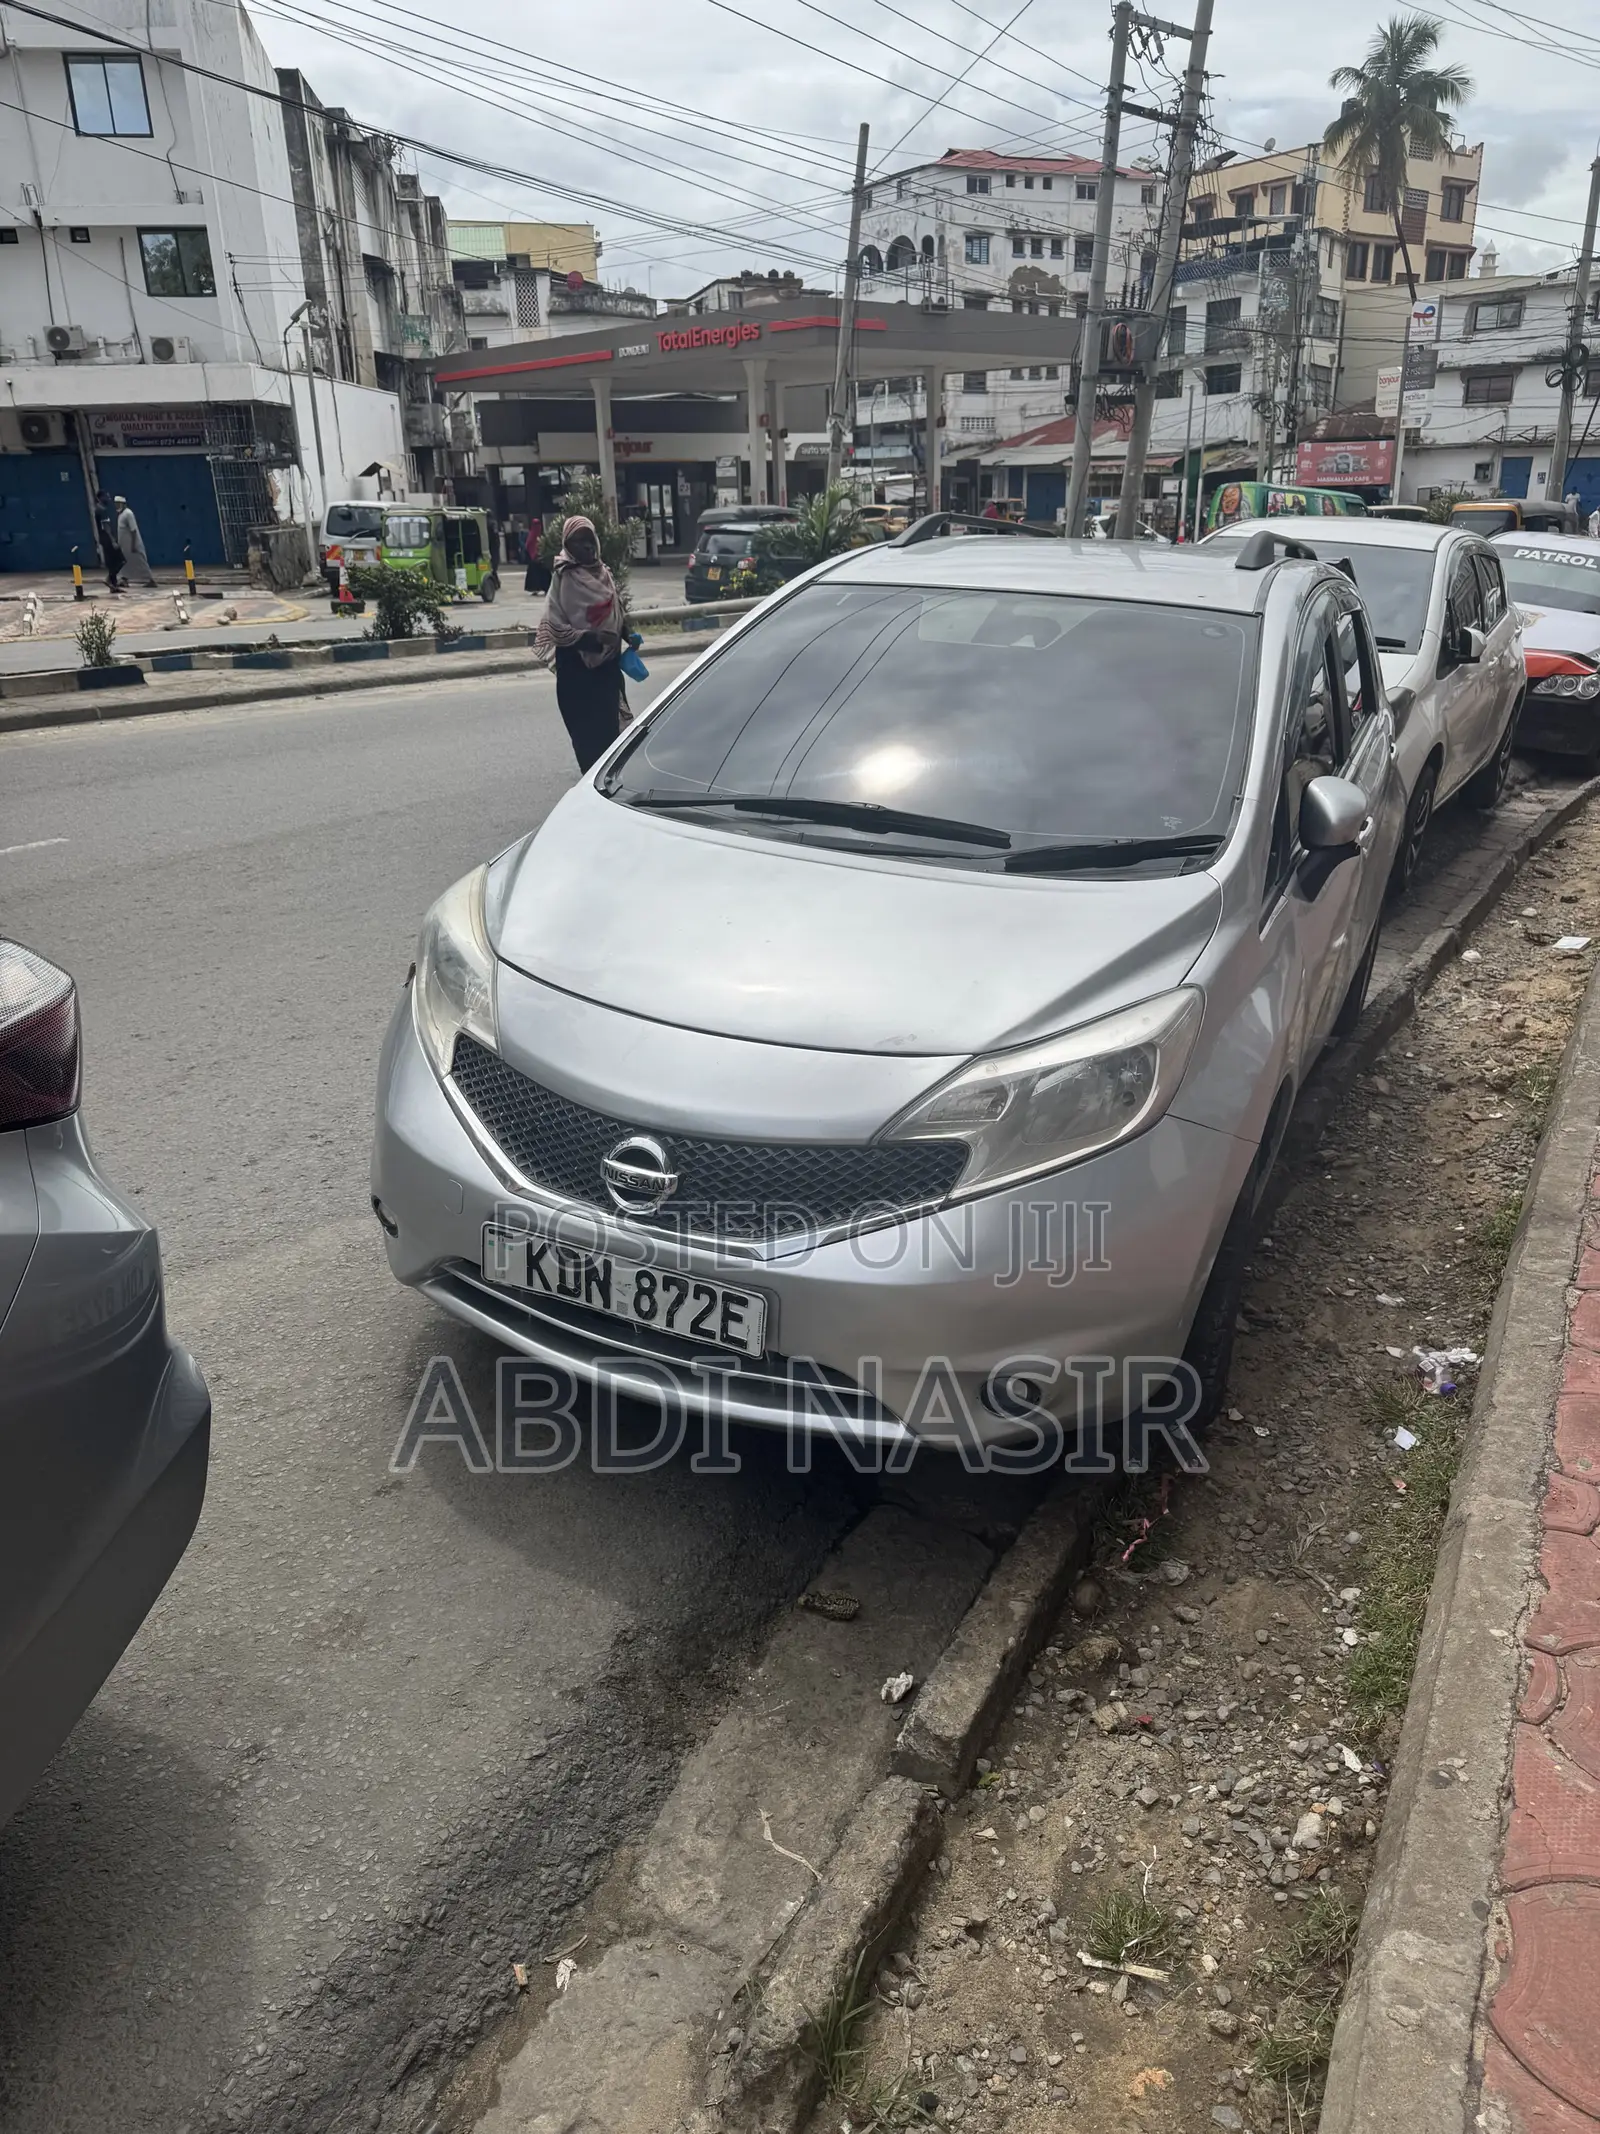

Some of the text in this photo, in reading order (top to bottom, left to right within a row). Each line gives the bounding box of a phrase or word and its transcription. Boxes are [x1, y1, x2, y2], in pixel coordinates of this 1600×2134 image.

[656, 320, 760, 352] TotalEnergies
[121, 422, 153, 431] QUALITY
[1514, 549, 1598, 569] PATROL
[604, 1165, 666, 1191] NISSAN
[526, 1238, 613, 1310] KDN
[633, 1269, 749, 1350] 872E
